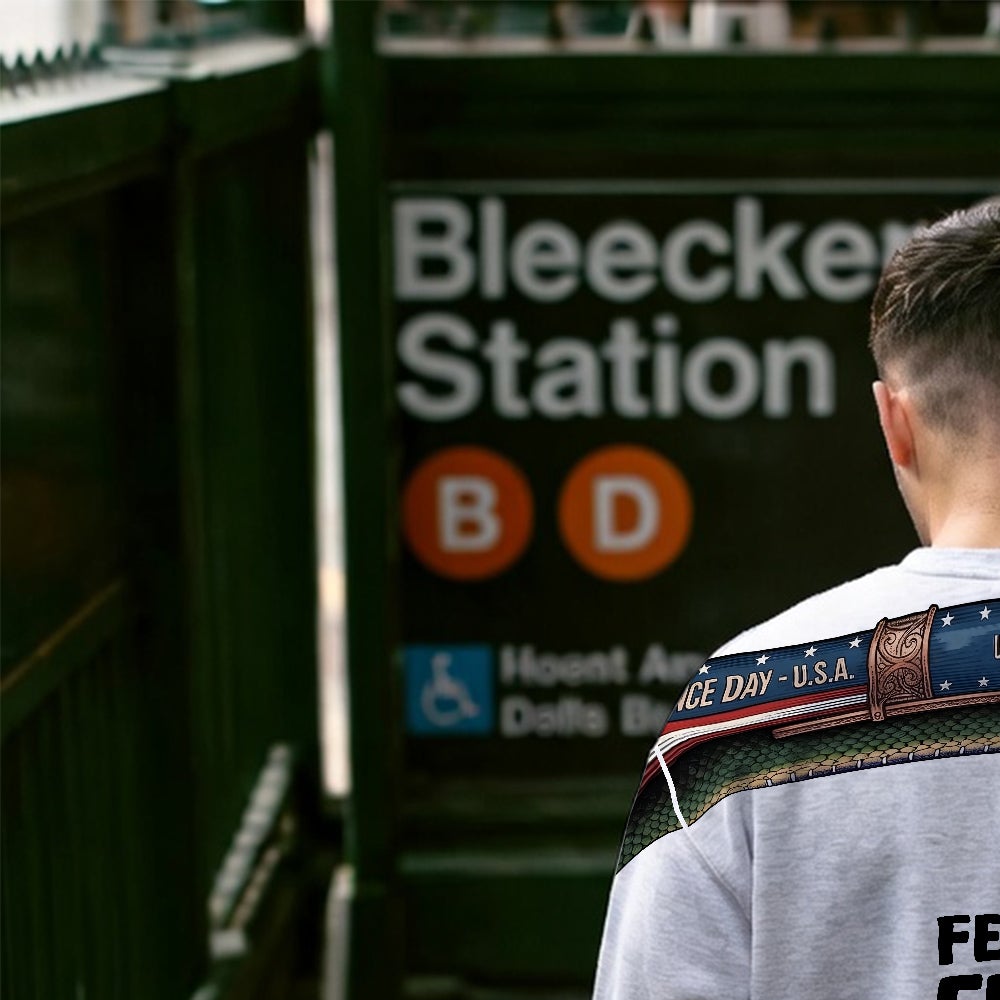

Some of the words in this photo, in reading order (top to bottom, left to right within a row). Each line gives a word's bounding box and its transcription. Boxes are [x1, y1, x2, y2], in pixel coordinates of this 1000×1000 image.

[397, 312, 836, 420] Station
[438, 474, 501, 552] B
[592, 474, 659, 552] D
[722, 669, 774, 703] DAY
[793, 657, 855, 689] U.S.A.
